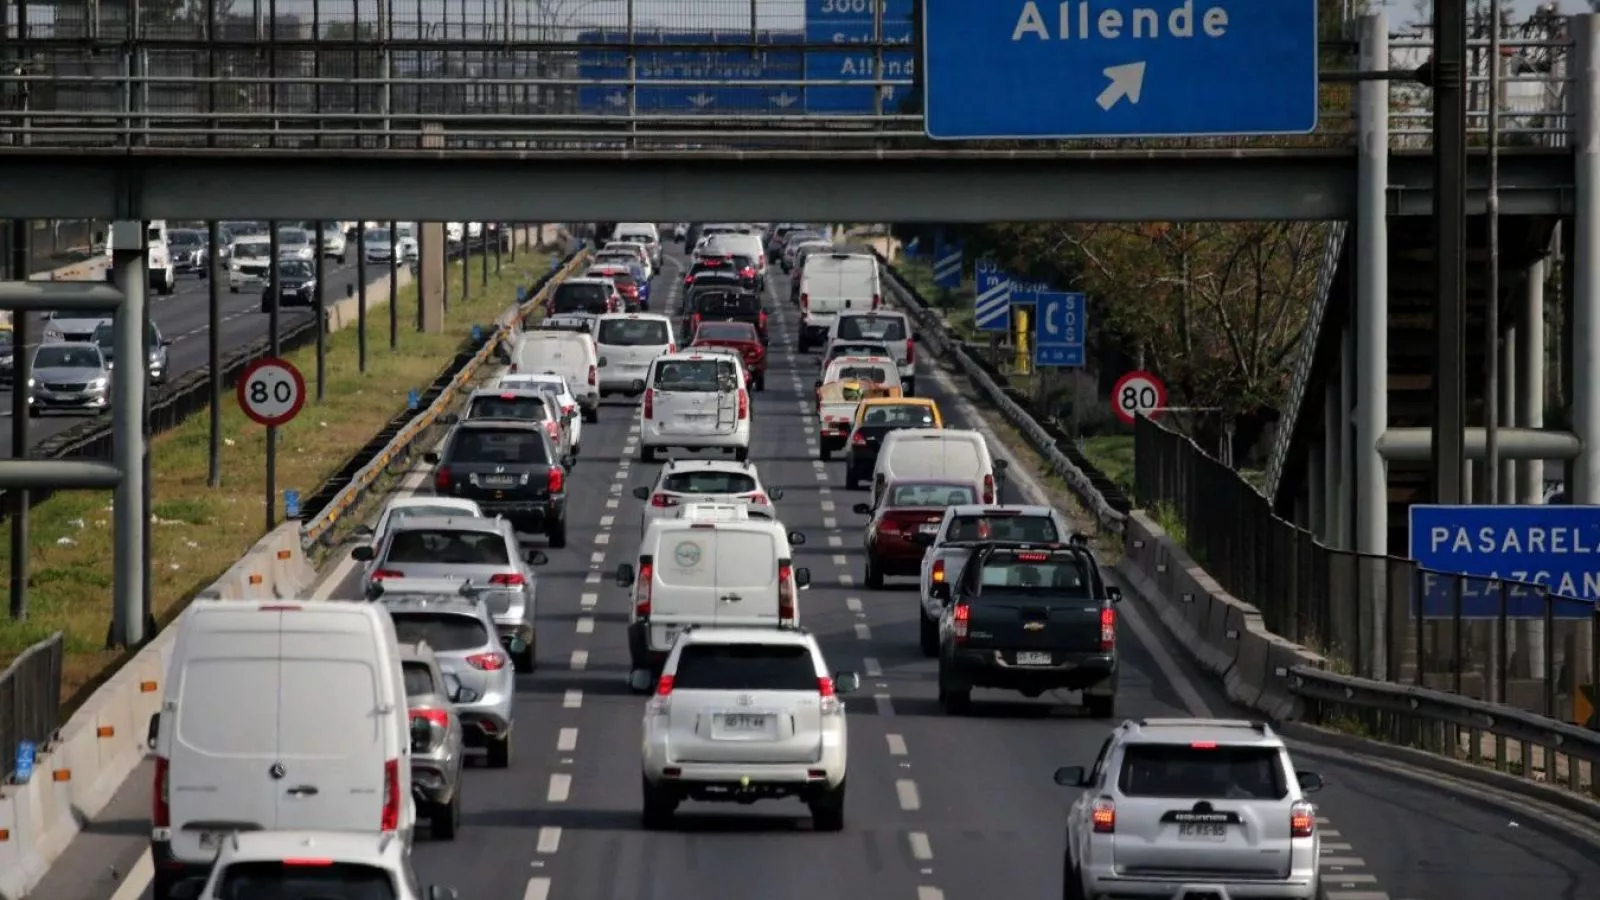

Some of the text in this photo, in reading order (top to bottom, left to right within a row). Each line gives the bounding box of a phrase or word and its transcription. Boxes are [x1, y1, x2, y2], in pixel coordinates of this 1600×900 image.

[1012, 0, 1229, 40] Allende
[840, 57, 914, 75] Allnd
[251, 380, 291, 404] 80
[1122, 387, 1156, 410] 80
[1431, 527, 1600, 553] PASAREL
